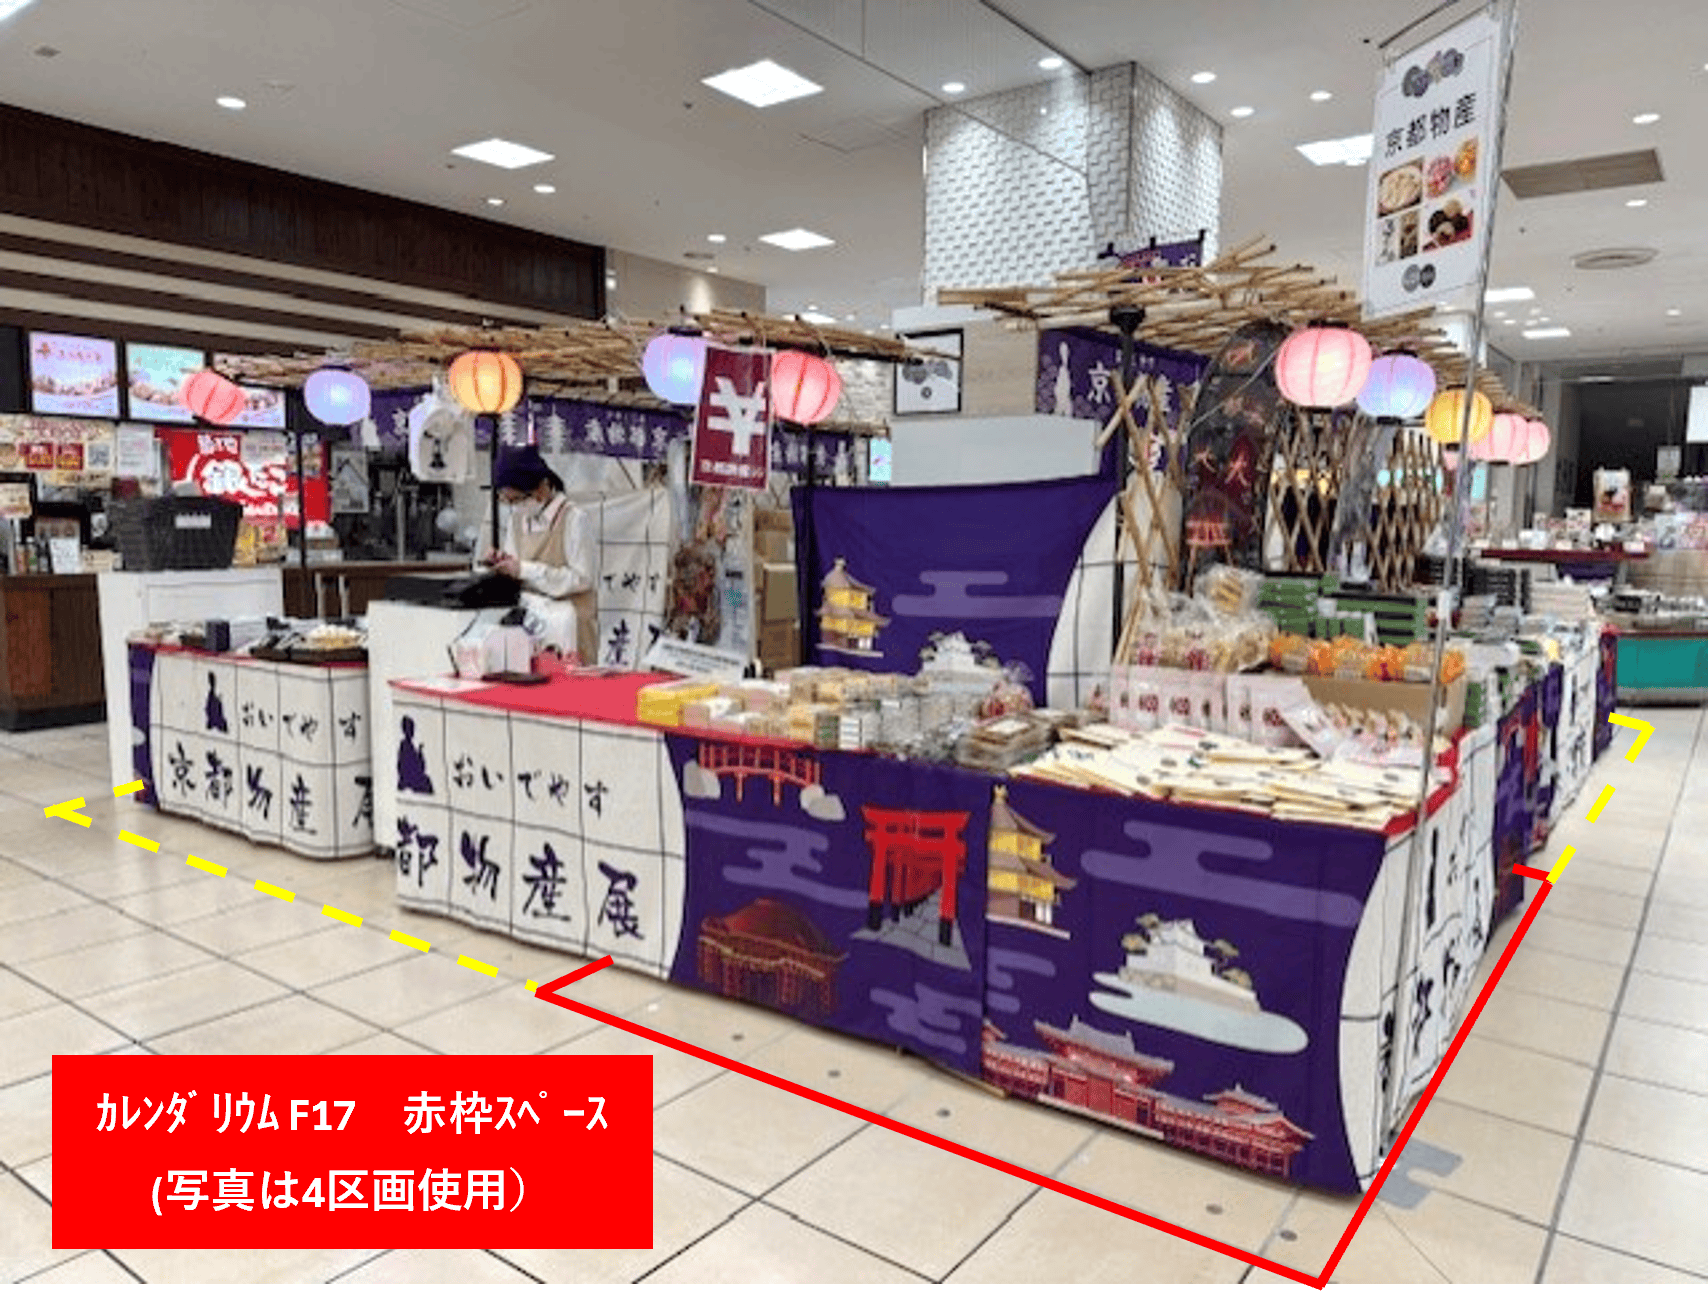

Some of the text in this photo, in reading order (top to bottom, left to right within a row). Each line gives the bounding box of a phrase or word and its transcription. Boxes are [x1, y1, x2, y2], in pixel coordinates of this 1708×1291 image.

[1385, 92, 1477, 159] 京都物産
[453, 754, 608, 819] おいでやす
